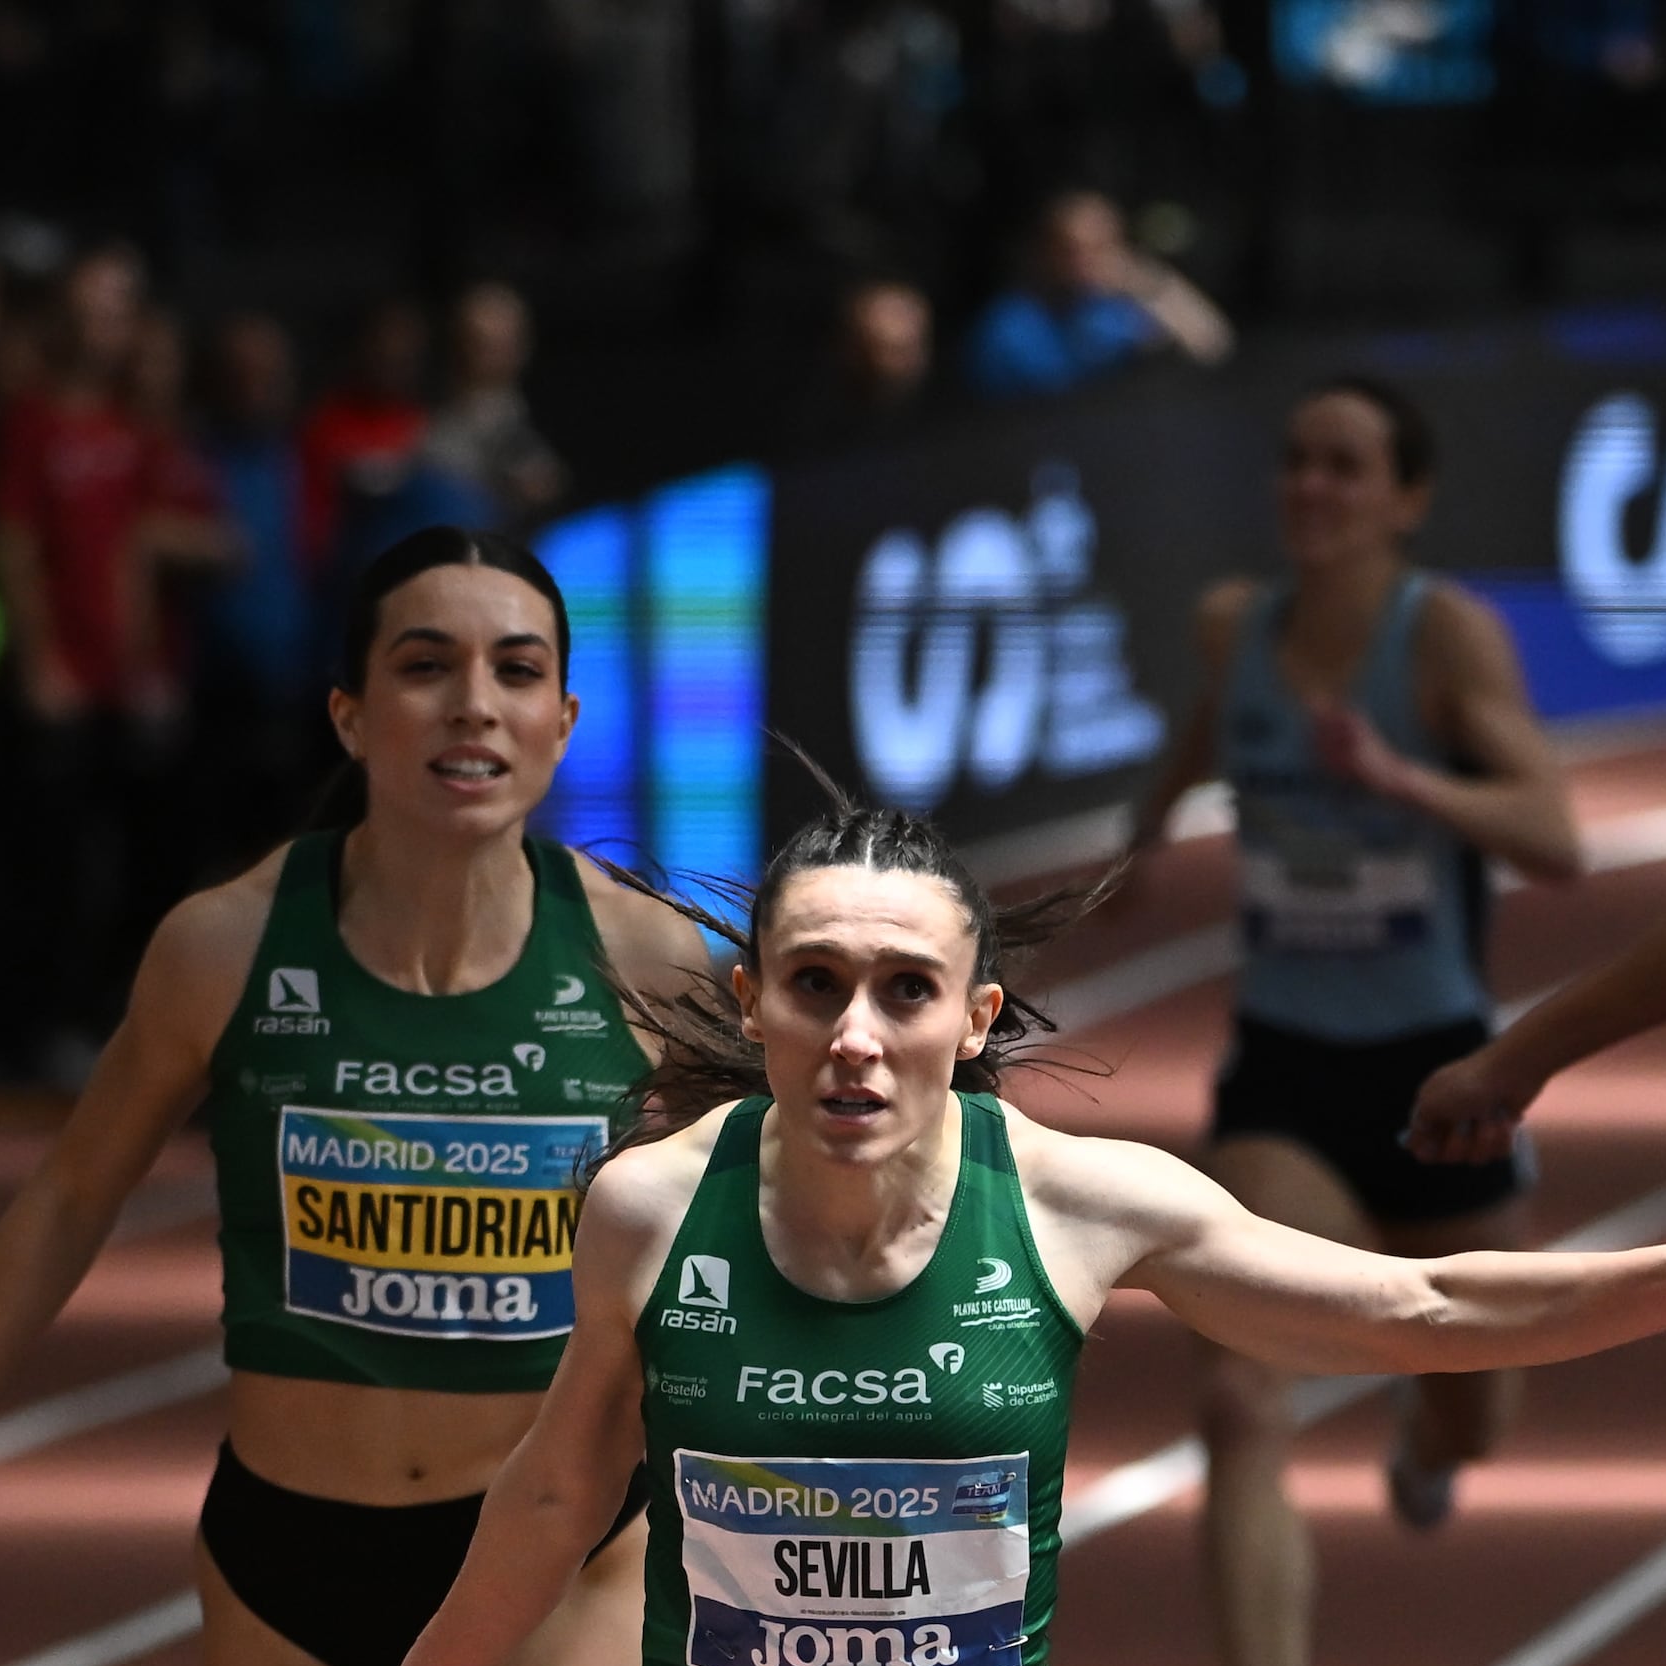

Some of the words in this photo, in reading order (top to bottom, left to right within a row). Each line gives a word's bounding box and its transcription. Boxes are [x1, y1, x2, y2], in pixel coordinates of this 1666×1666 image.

[335, 1060, 519, 1097] Facsa
[287, 1132, 436, 1171] MADRID
[444, 1141, 531, 1176] 2025
[343, 1266, 539, 1323] Joma
[953, 1302, 980, 1318] PLAYAS
[981, 1300, 993, 1314] DE
[660, 1308, 738, 1335] rasán
[736, 1365, 932, 1405] Facsa
[1007, 1377, 1055, 1396] Diputació
[758, 1410, 795, 1421] ciclo
[800, 1410, 860, 1424] integral
[866, 1410, 890, 1421] del
[895, 1411, 933, 1424] agua
[1009, 1396, 1025, 1407] de
[690, 1479, 840, 1518] MADRID
[850, 1487, 940, 1519] 2025
[967, 1483, 1001, 1497] TEAM
[774, 1539, 932, 1599] SEVILLA
